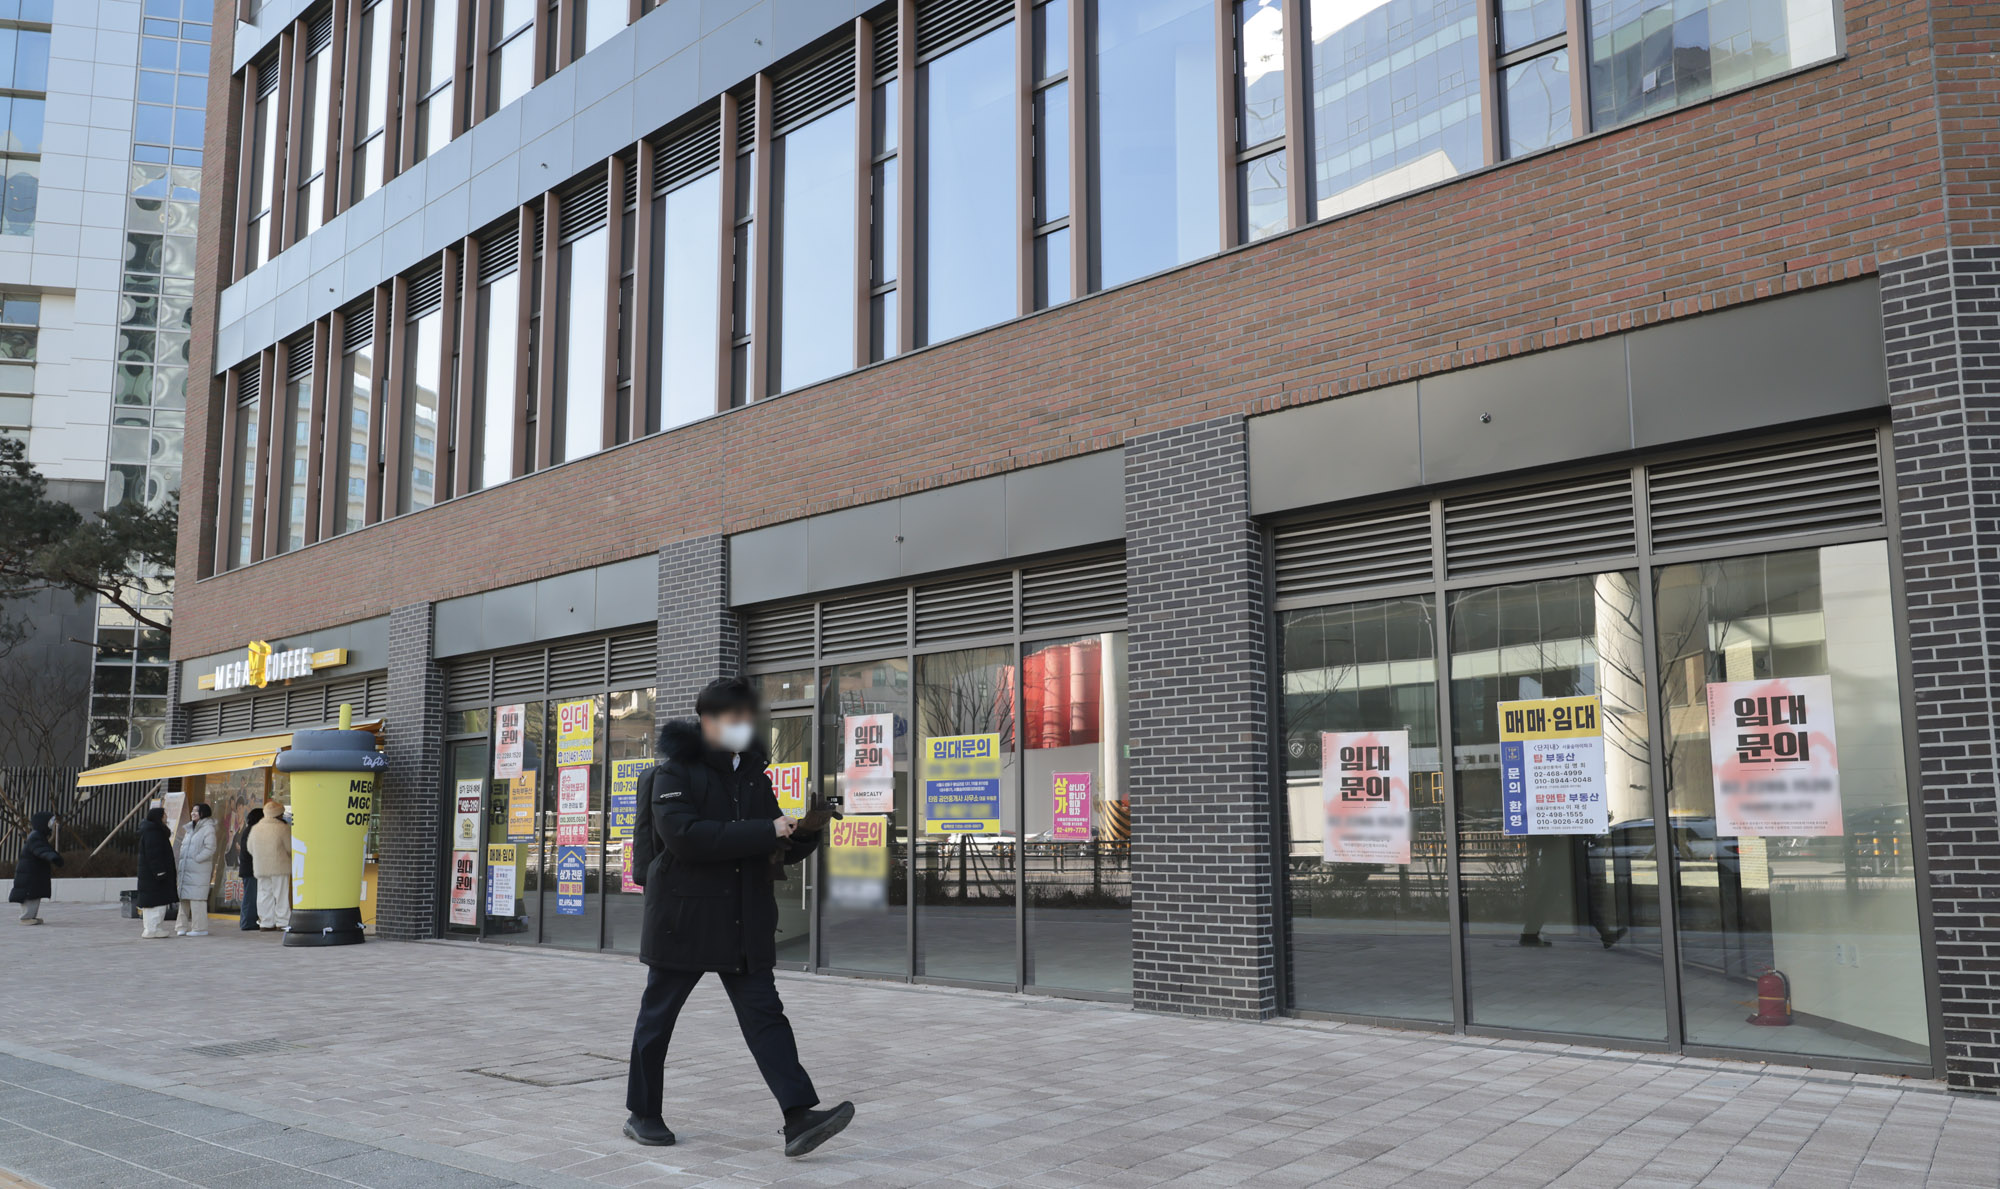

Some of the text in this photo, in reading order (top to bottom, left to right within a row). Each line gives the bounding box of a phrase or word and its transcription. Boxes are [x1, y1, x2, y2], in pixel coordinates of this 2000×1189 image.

[215, 660, 249, 691] MEGA
[265, 648, 313, 682] COFFEE
[502, 713, 518, 728] 임대
[561, 703, 588, 732] 임대
[1505, 705, 1596, 733] 매매·임대
[1733, 695, 1807, 727] 임대
[501, 730, 518, 745] 문의
[855, 725, 883, 745] 임대
[854, 747, 883, 767] 문의
[933, 738, 991, 759] 임대문의
[1736, 731, 1810, 763] 문의
[1340, 746, 1390, 771] 임대
[1533, 752, 1575, 763] 탑 부동산
[350, 780, 373, 793] MEG
[1340, 776, 1391, 801] 문의
[1534, 777, 1592, 785] 010-8944-0048
[347, 797, 370, 809] MGC
[1055, 778, 1069, 814] 상가
[1535, 792, 1599, 803] 탑앤탑 부동산
[833, 822, 882, 847] 상가문의
[458, 859, 472, 874] 임대
[560, 869, 582, 880] 상가 전문
[456, 876, 472, 891] 문의
